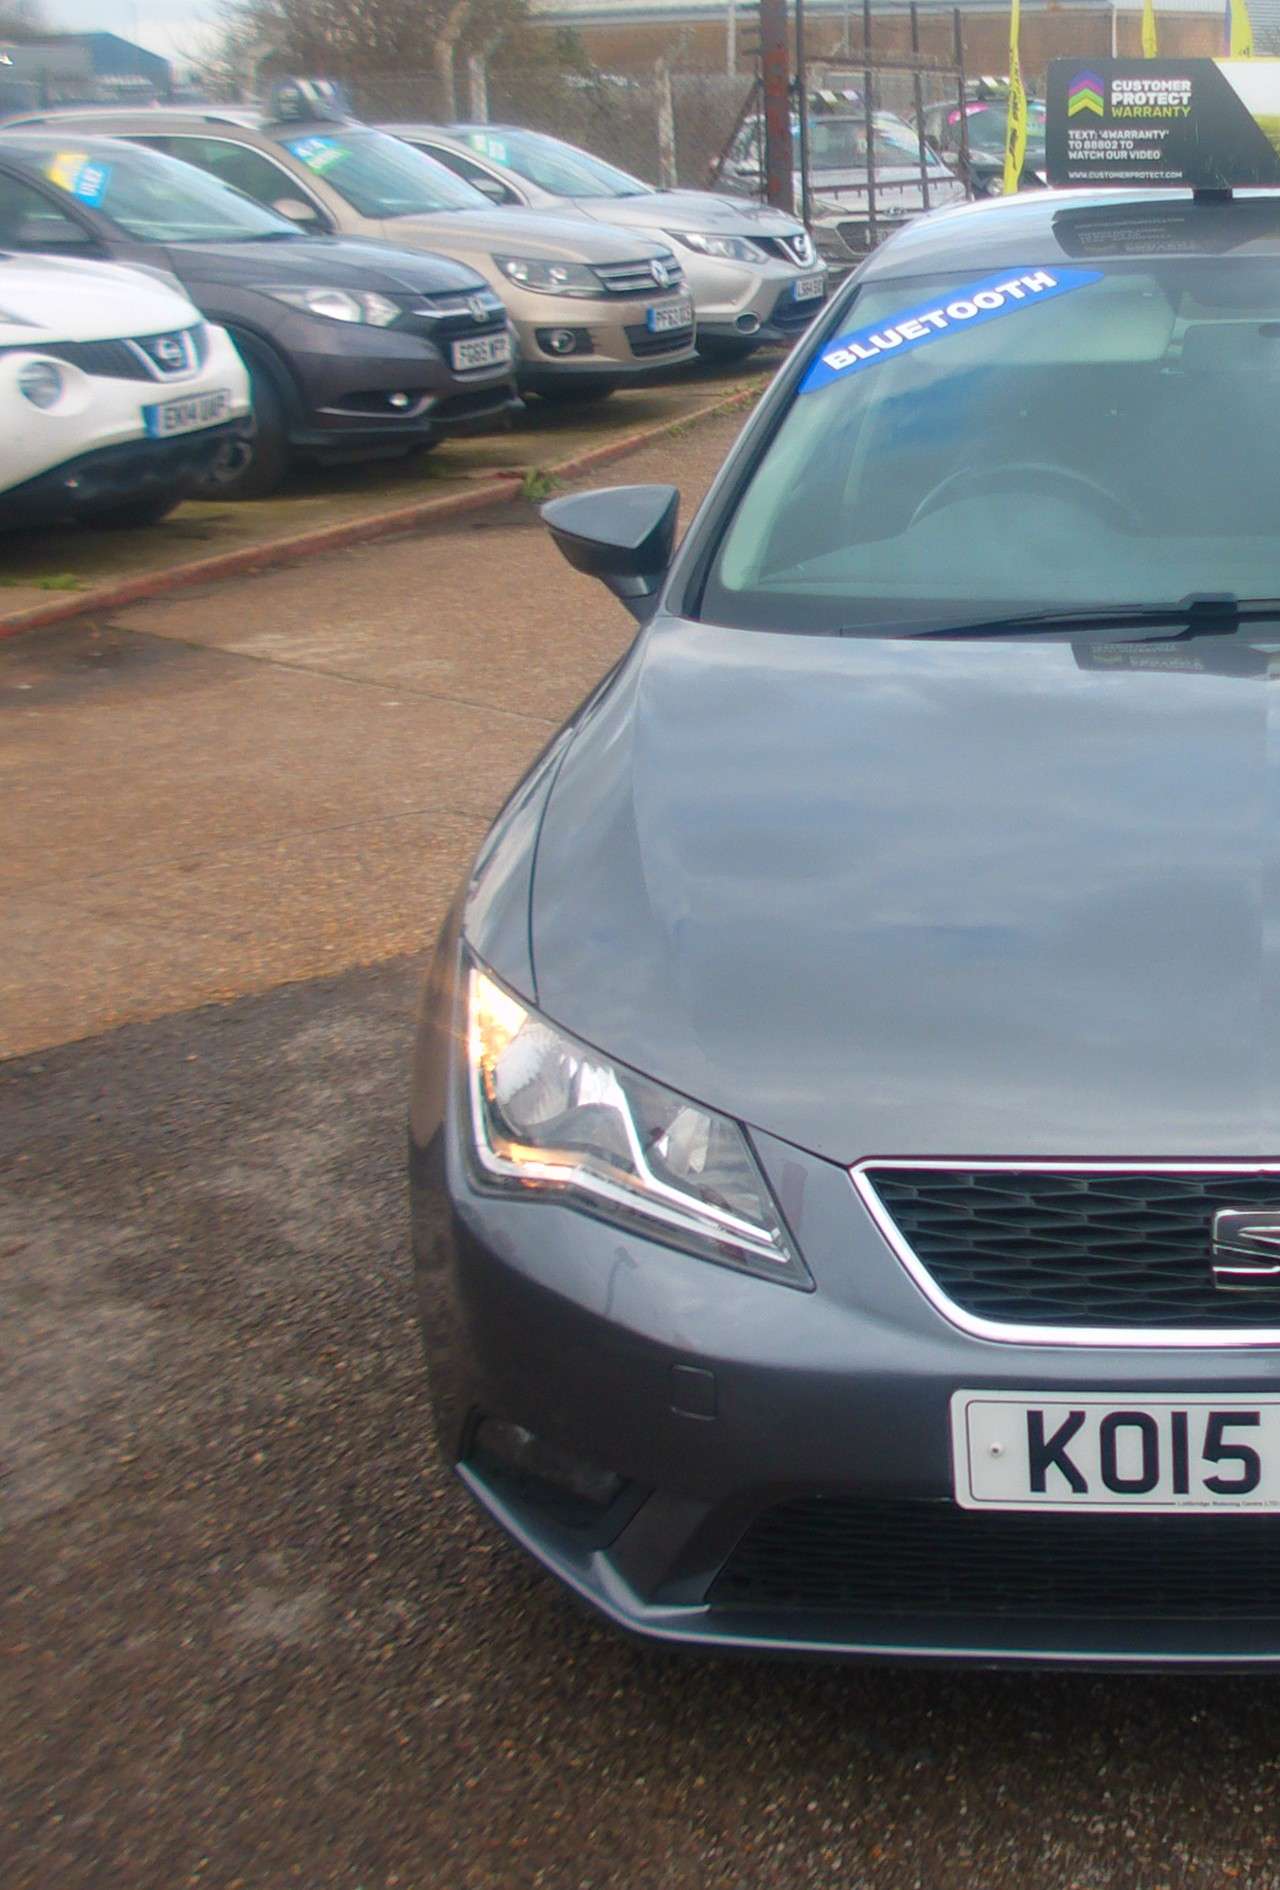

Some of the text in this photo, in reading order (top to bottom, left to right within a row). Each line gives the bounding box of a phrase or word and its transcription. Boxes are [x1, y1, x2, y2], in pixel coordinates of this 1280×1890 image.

[1111, 80, 1192, 91] CUSTOMER
[1111, 92, 1192, 105] PROTECT
[1111, 106, 1191, 118] WARRANTY
[1068, 130, 1098, 140] TEXT:
[1068, 141, 1082, 149] TO
[1120, 141, 1134, 149] TO
[1068, 151, 1161, 160] WATCH OUR VIDEO
[822, 271, 1057, 371] BLUETOOTH
[1026, 1409, 1262, 1495] KO15
